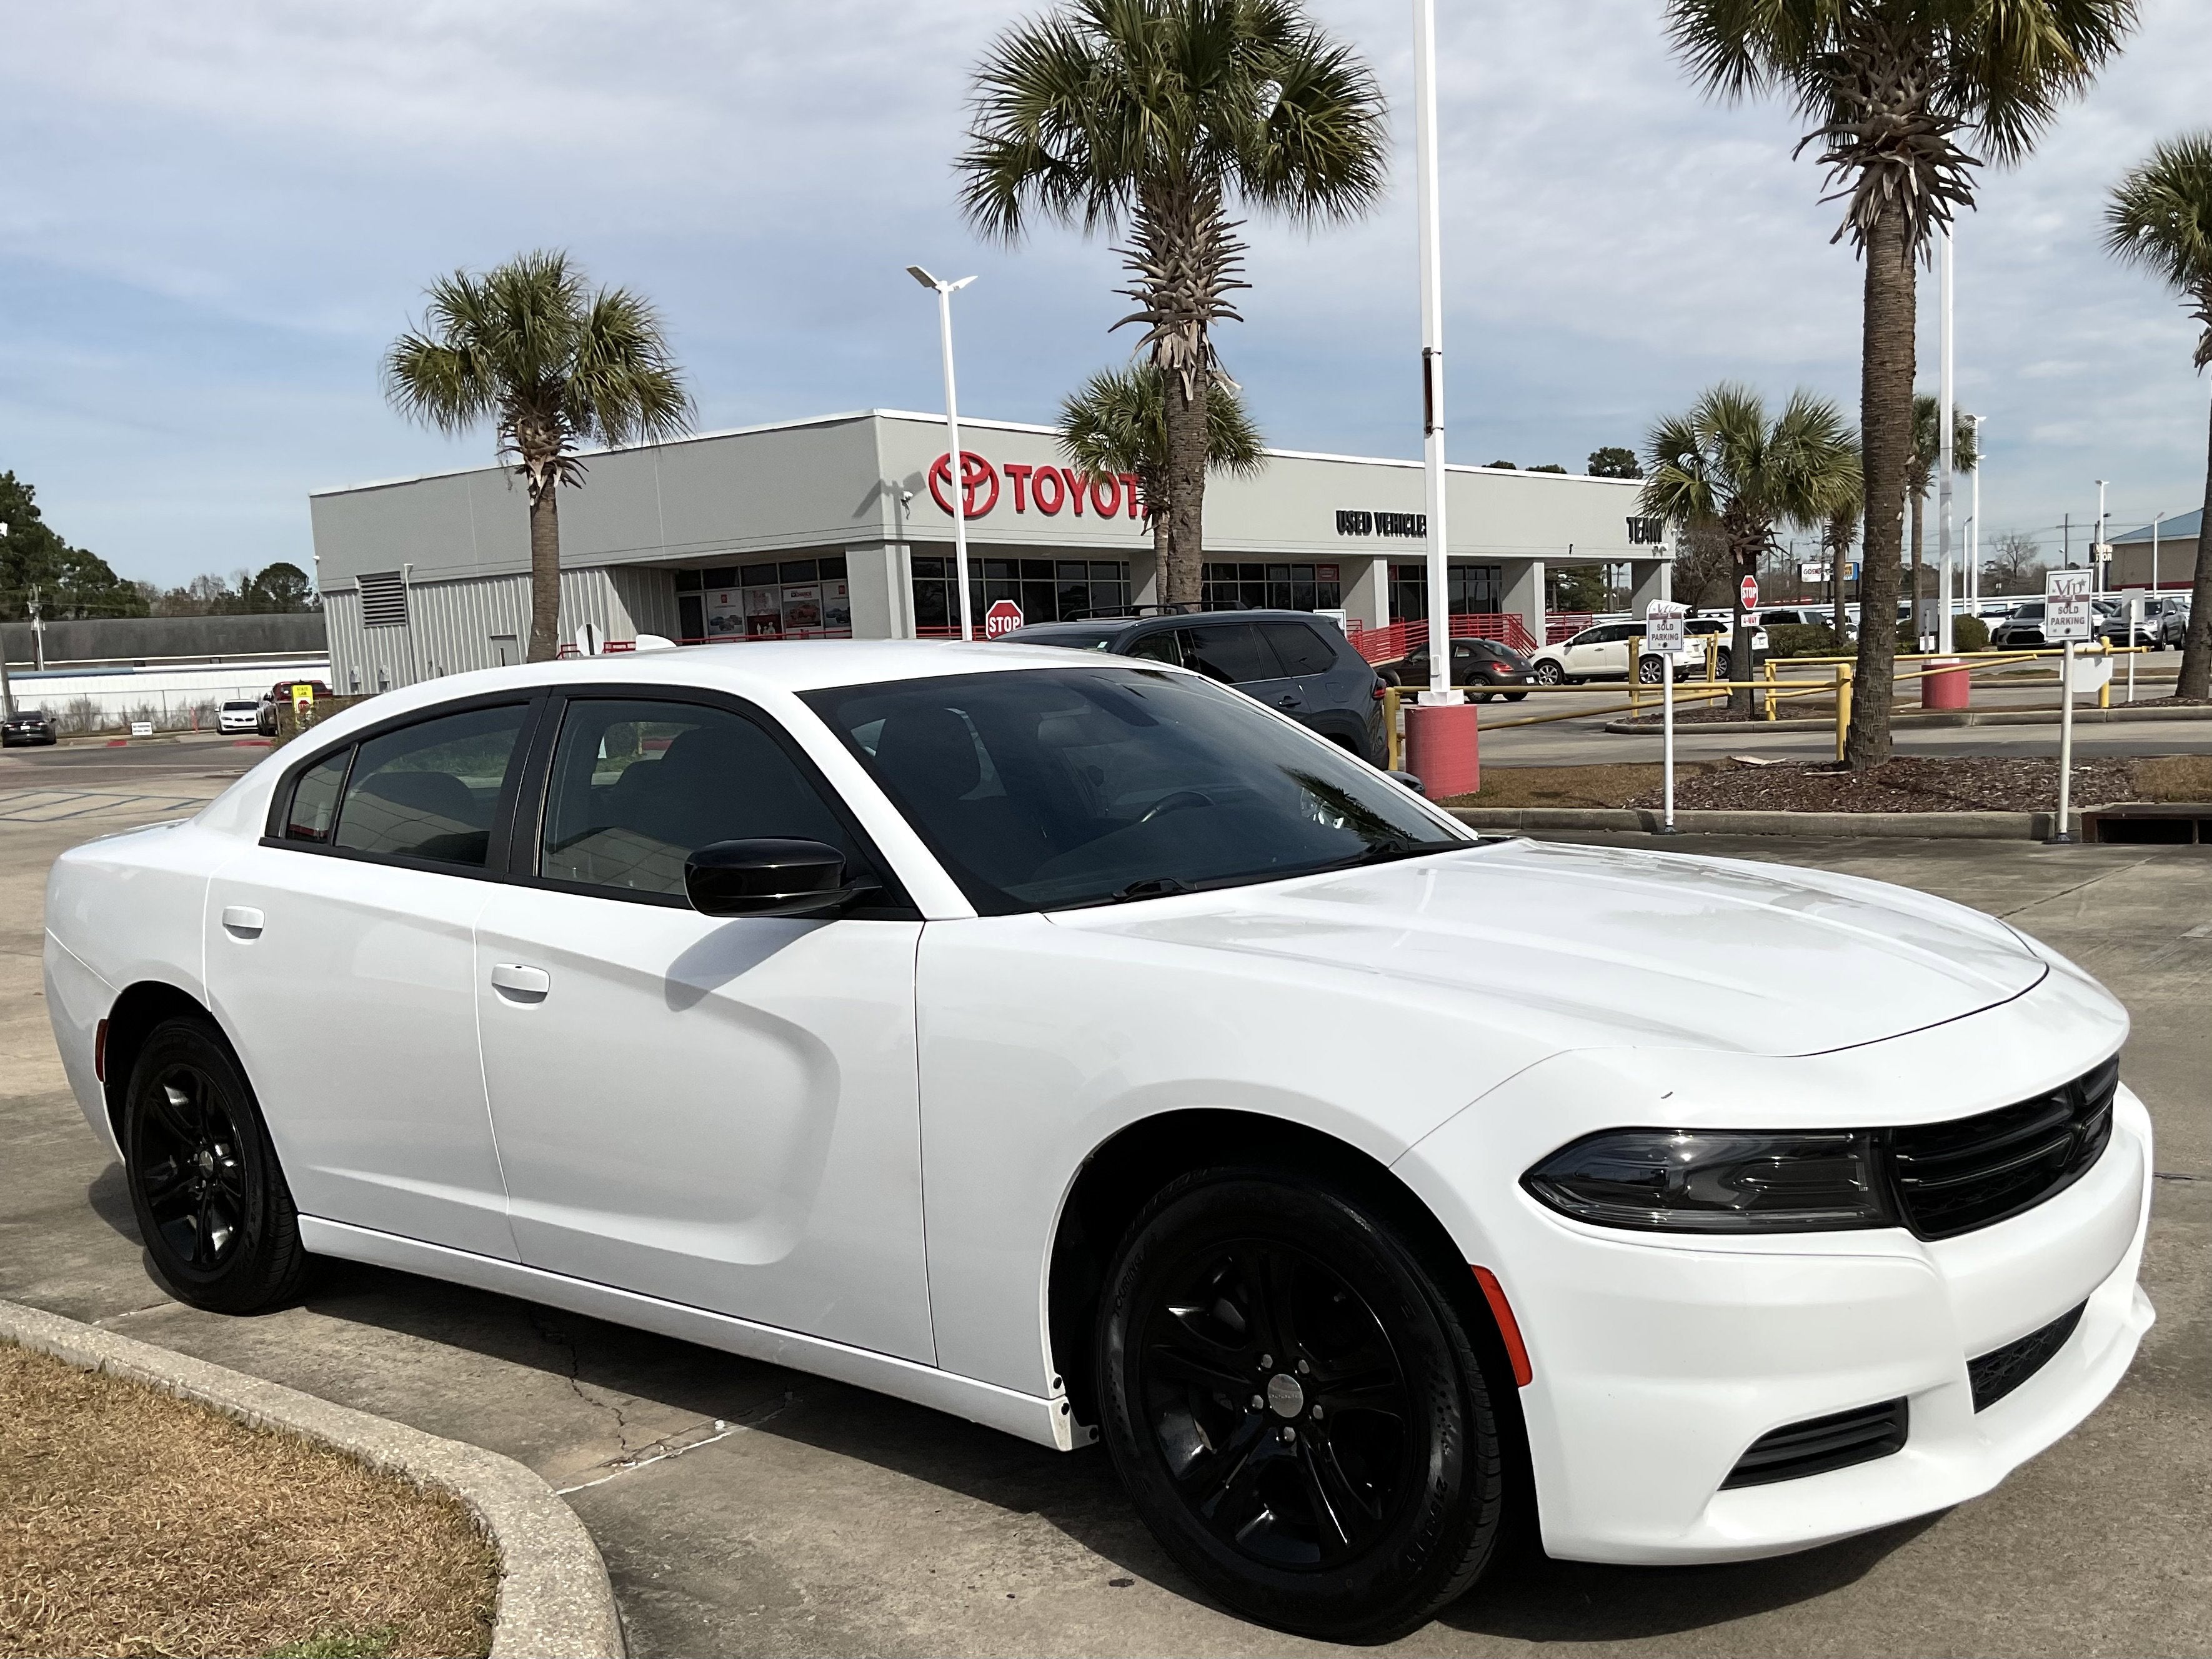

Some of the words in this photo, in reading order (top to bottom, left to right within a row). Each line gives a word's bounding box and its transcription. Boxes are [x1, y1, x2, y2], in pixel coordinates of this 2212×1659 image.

[1004, 464, 1151, 519] TOYOT
[1335, 511, 1372, 536] USED
[1373, 512, 1427, 538] VEHICLE
[1626, 516, 1661, 544] TEAM
[1742, 587, 1756, 599] STOP
[2058, 606, 2079, 614] SOLD
[989, 616, 1020, 632] STOP
[2051, 617, 2085, 625] PARKING
